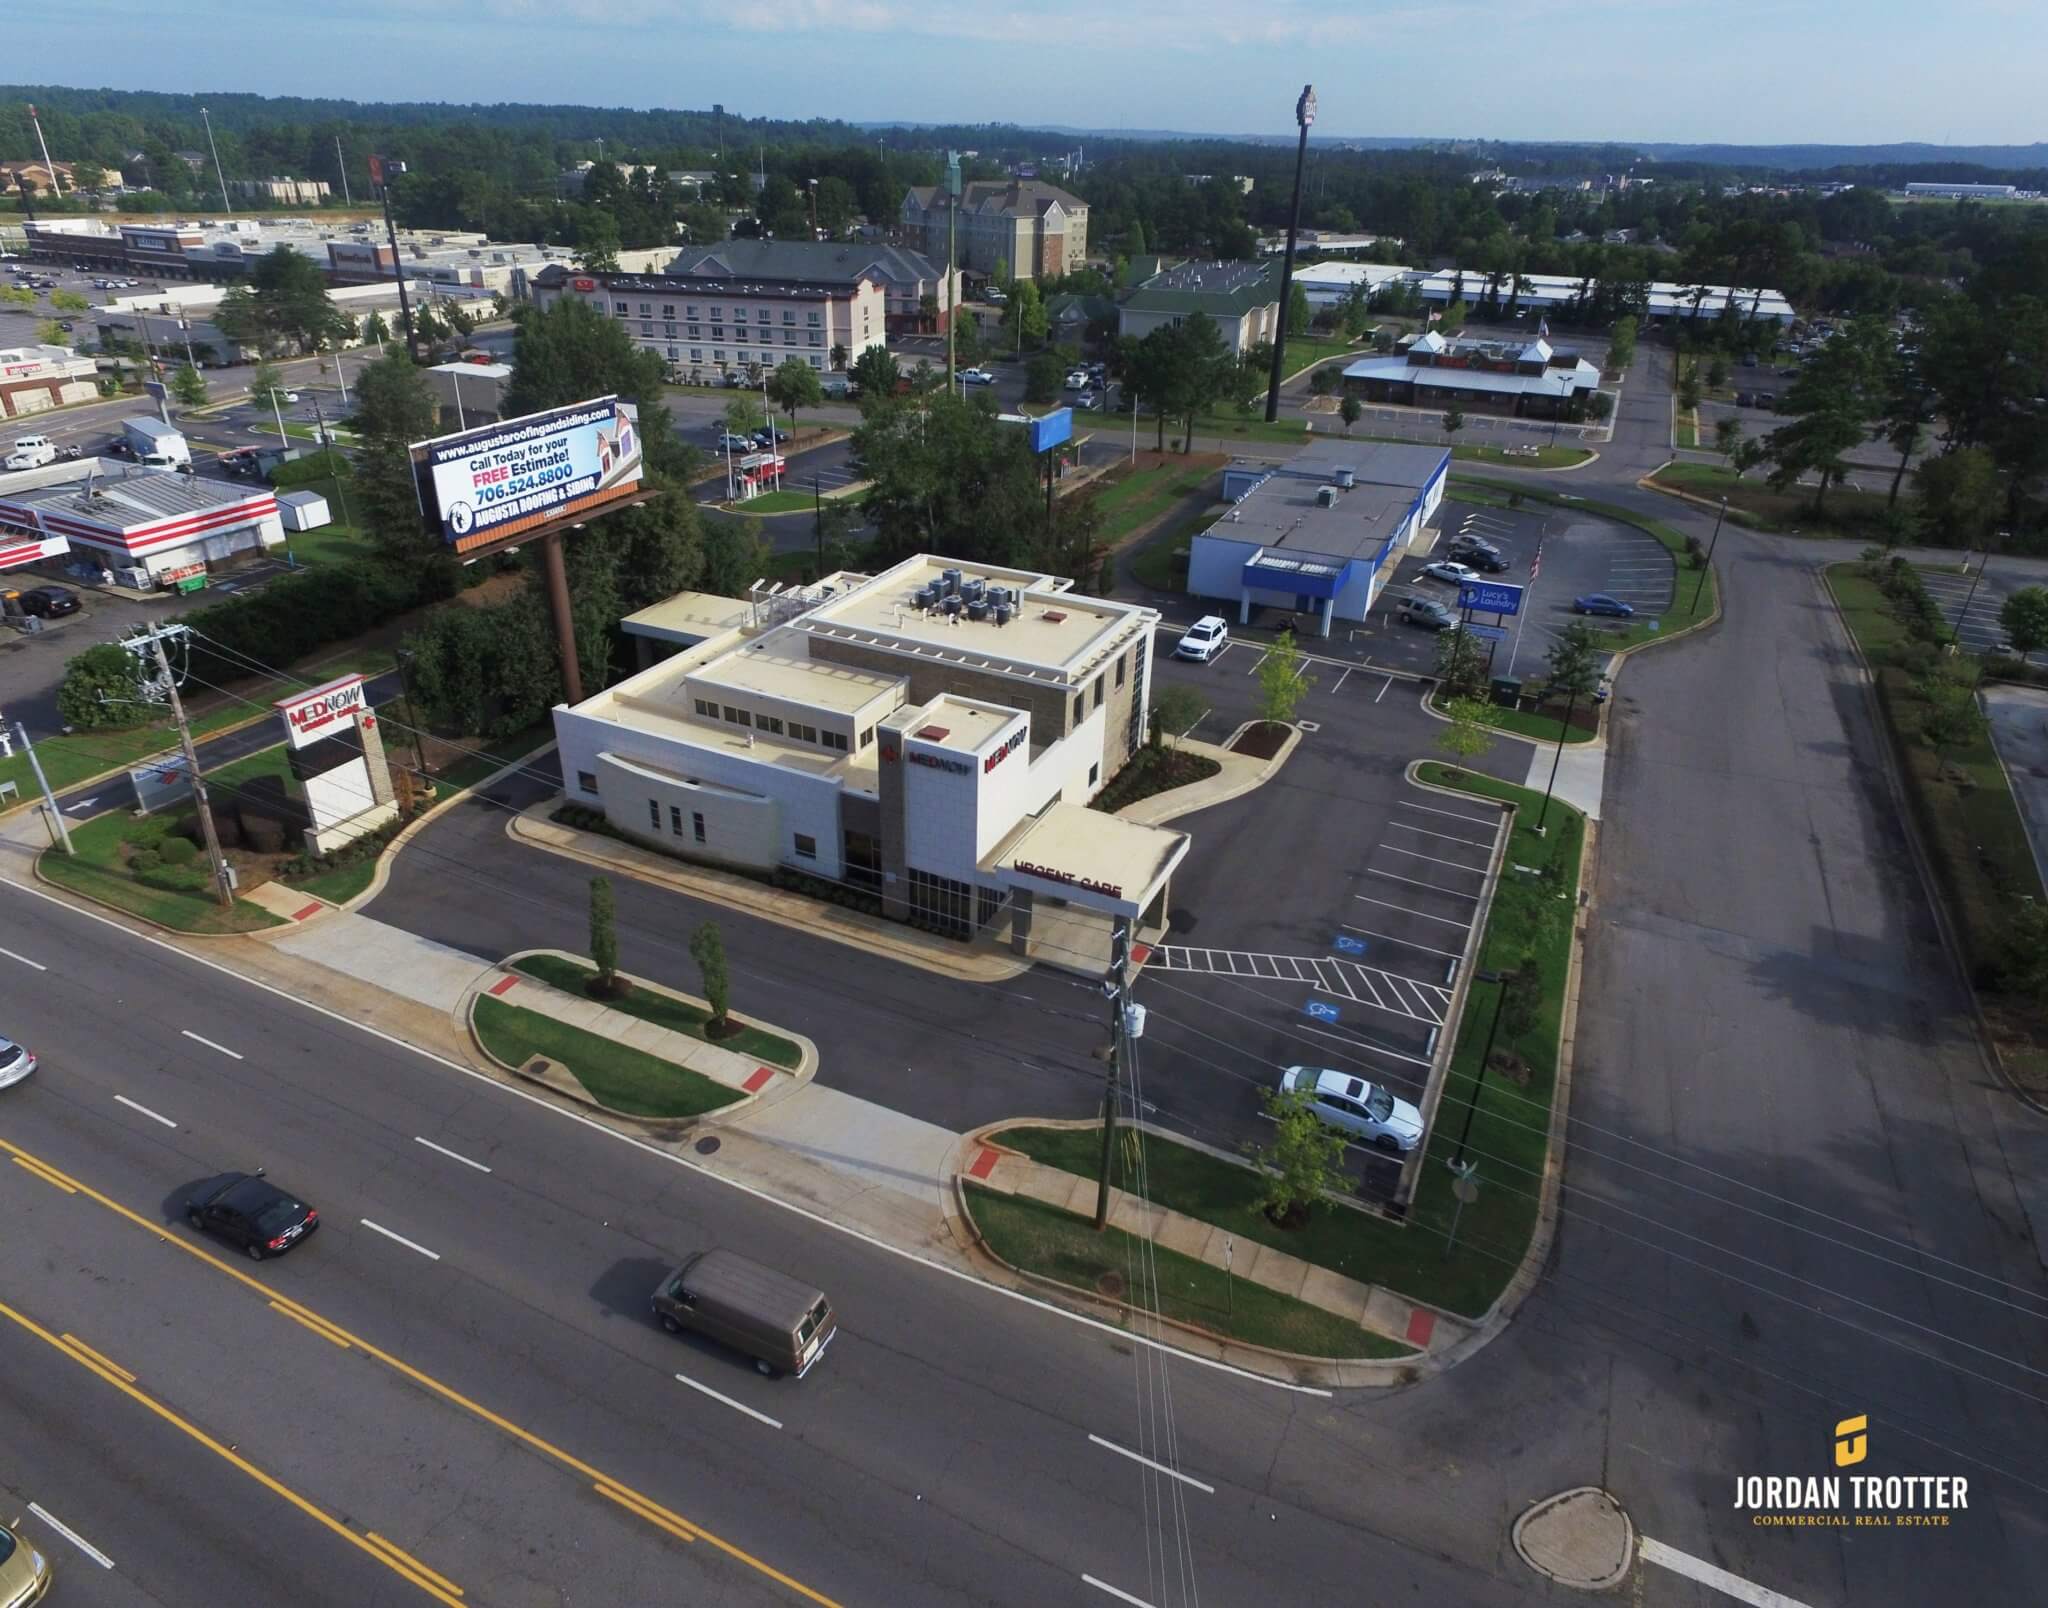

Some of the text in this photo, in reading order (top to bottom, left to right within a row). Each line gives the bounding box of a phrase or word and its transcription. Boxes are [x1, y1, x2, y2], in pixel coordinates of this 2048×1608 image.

[437, 407, 610, 462] www.augustaroofingandsiding.com
[470, 438, 568, 472] Call Today for your
[472, 449, 569, 488] FREE Estimate!
[475, 463, 573, 505] 706.524.8800
[475, 501, 519, 528] AUGUSTA
[519, 490, 558, 516] ROOFING
[559, 486, 566, 500] &
[566, 476, 596, 498] SIDING
[1480, 597, 1517, 610] Laundry
[1481, 588, 1510, 600] Lucy's
[1014, 859, 1123, 899] URGENT CARE
